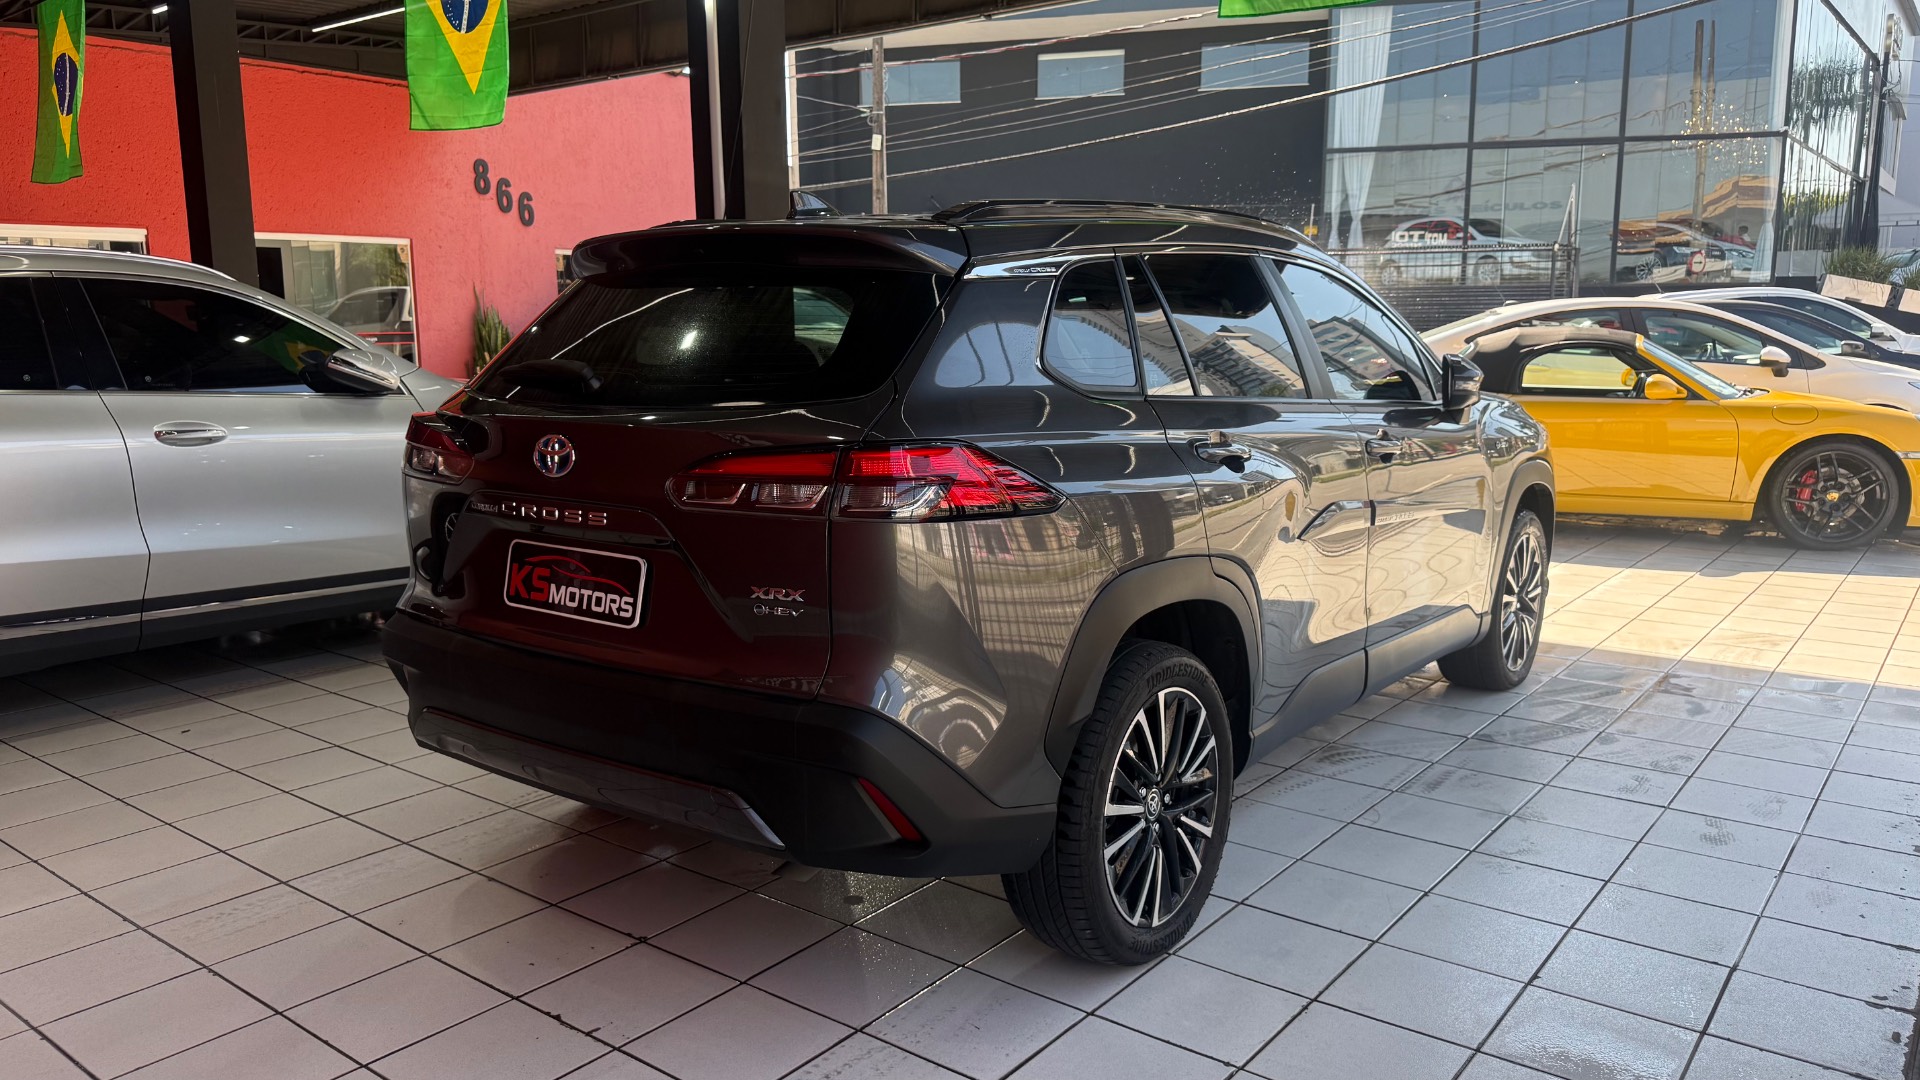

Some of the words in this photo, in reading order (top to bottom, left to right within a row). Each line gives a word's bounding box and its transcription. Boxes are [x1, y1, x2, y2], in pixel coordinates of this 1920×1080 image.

[473, 158, 535, 227] 866
[501, 500, 608, 526] CROSS
[548, 583, 635, 618] MOTORS
[750, 585, 806, 602] XRX
